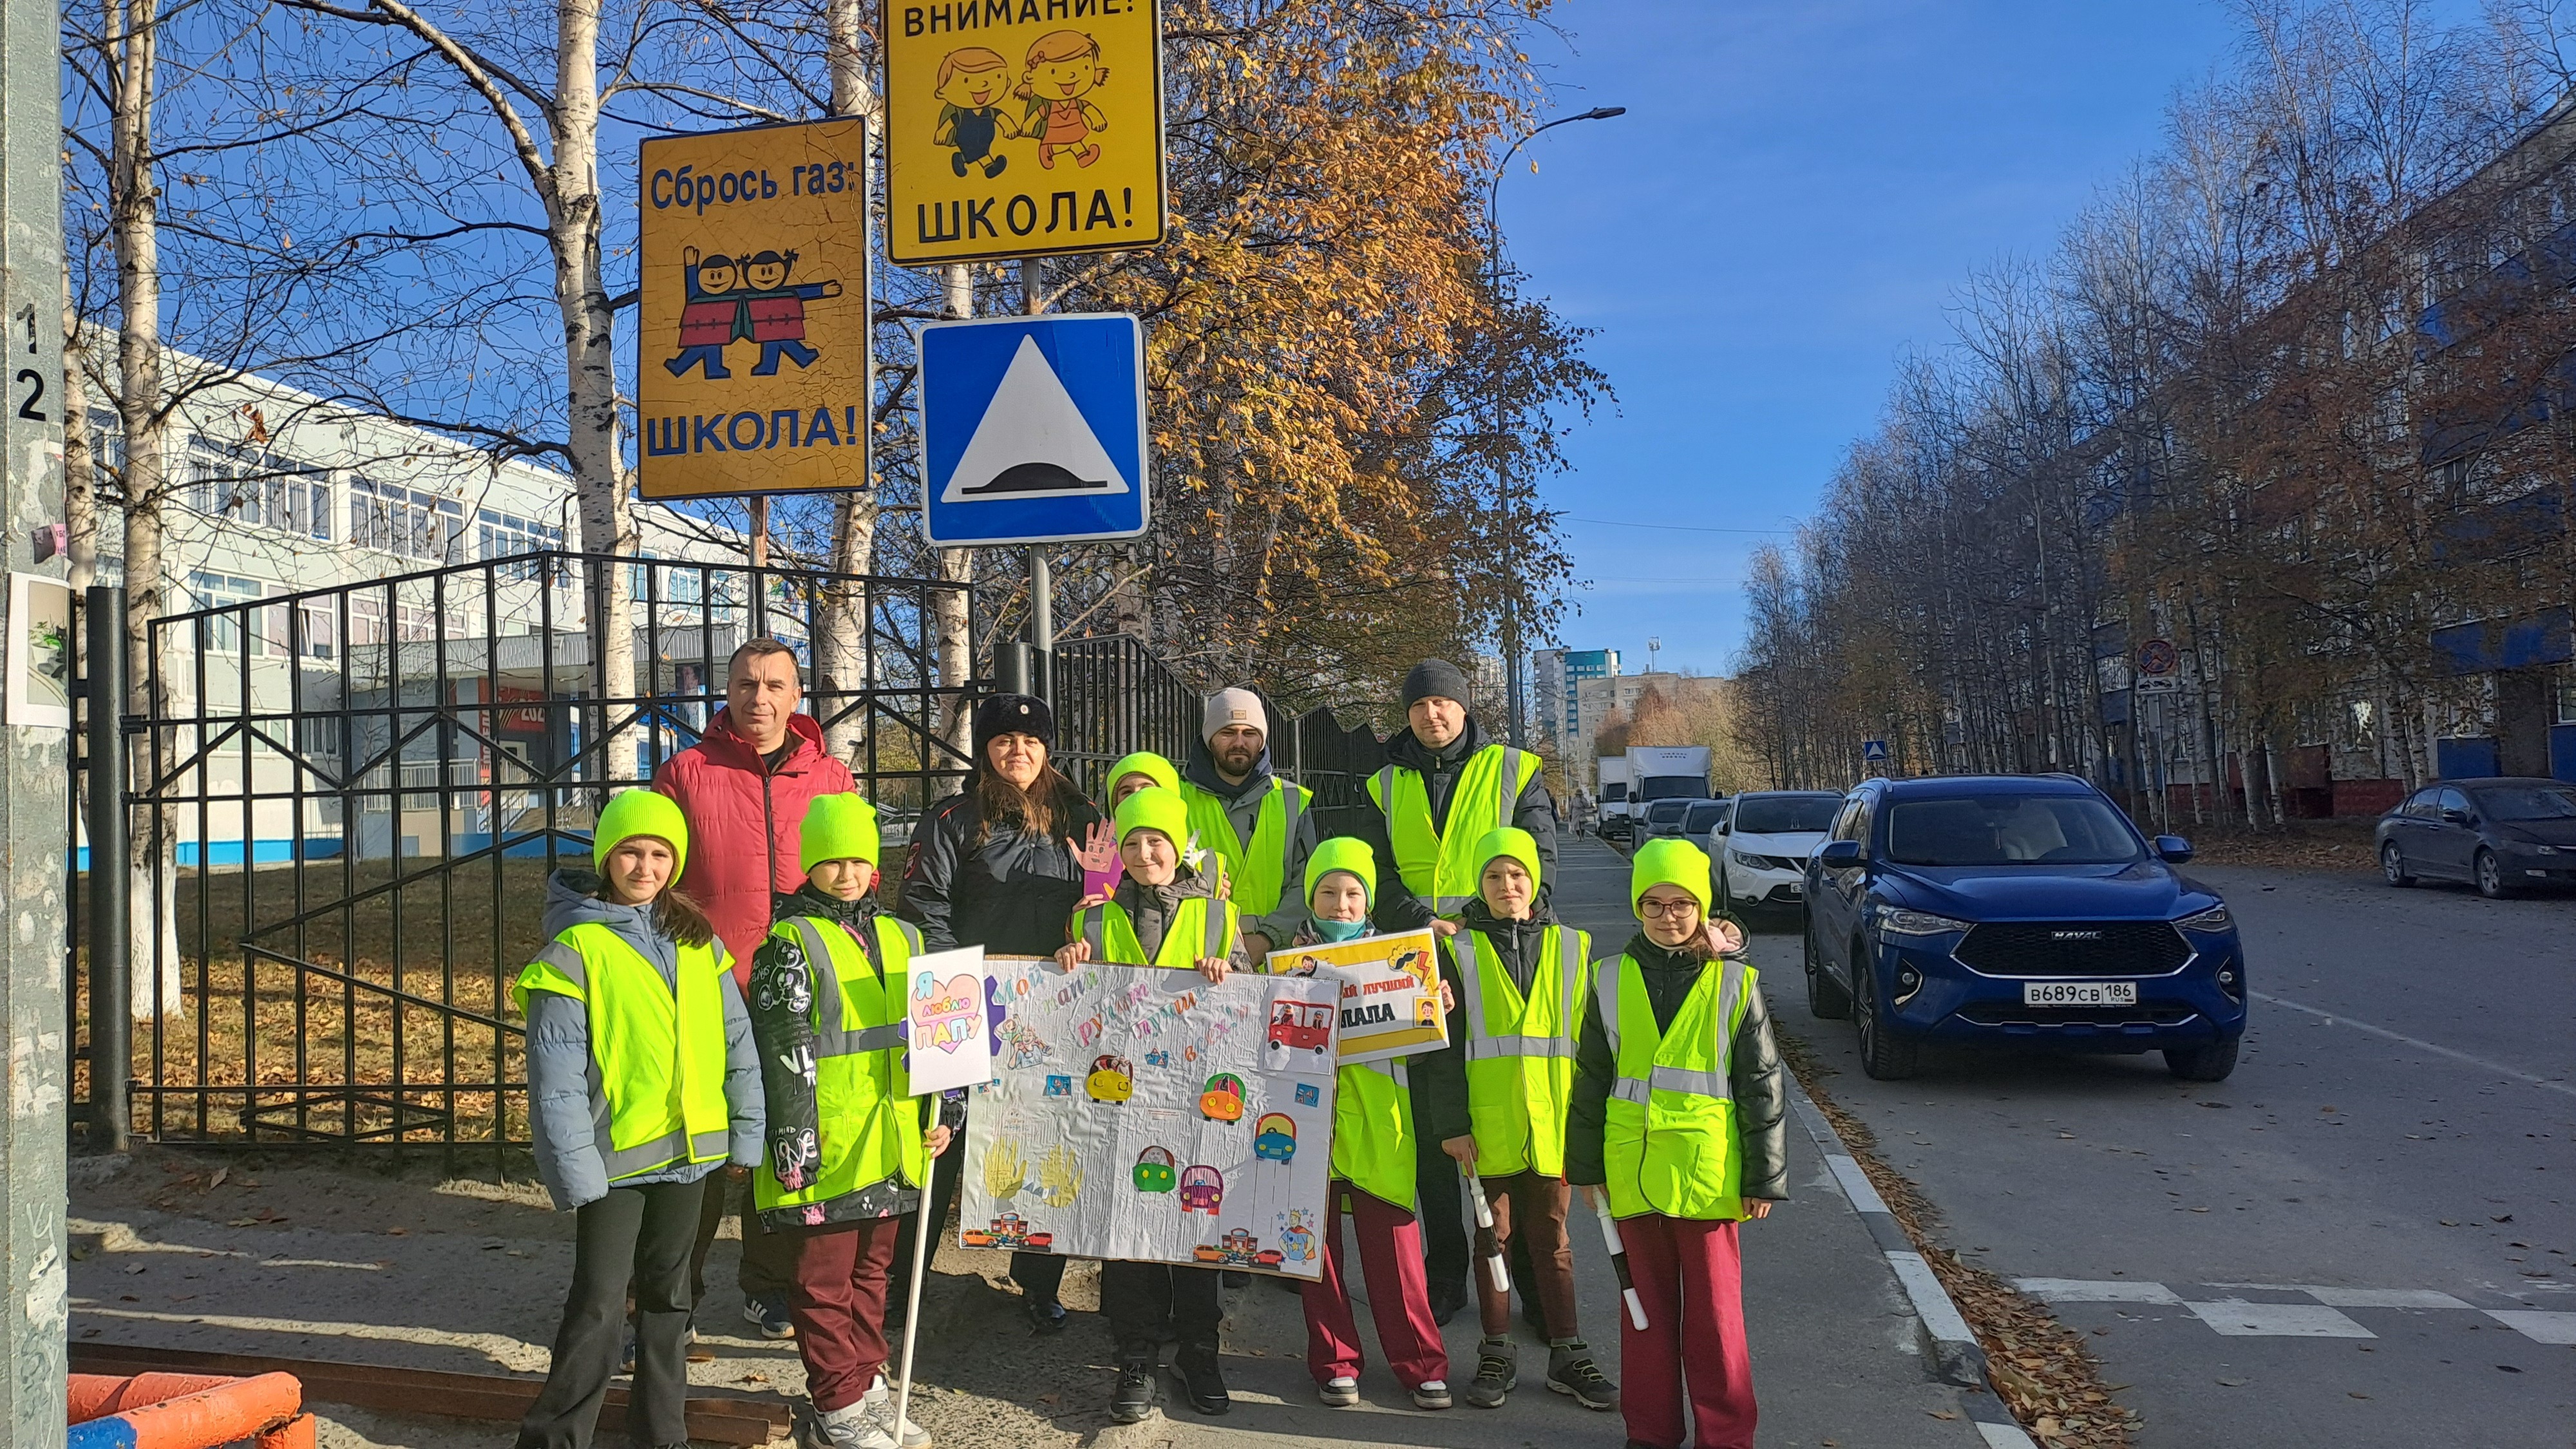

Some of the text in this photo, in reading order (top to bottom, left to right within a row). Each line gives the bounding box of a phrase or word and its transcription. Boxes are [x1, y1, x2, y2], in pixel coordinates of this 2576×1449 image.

[651, 164, 777, 216] Сбрось
[918, 187, 1133, 243] ШКОЛА!
[647, 406, 857, 457] ШКОЛА!
[2053, 931, 2101, 940] HAVAL
[916, 971, 934, 1001] Я
[1363, 975, 1415, 996] ЛУЧШИЙ
[2105, 985, 2131, 997] 186
[1341, 1003, 1396, 1028] ПАПА
[914, 1014, 982, 1050] ПАПУ
